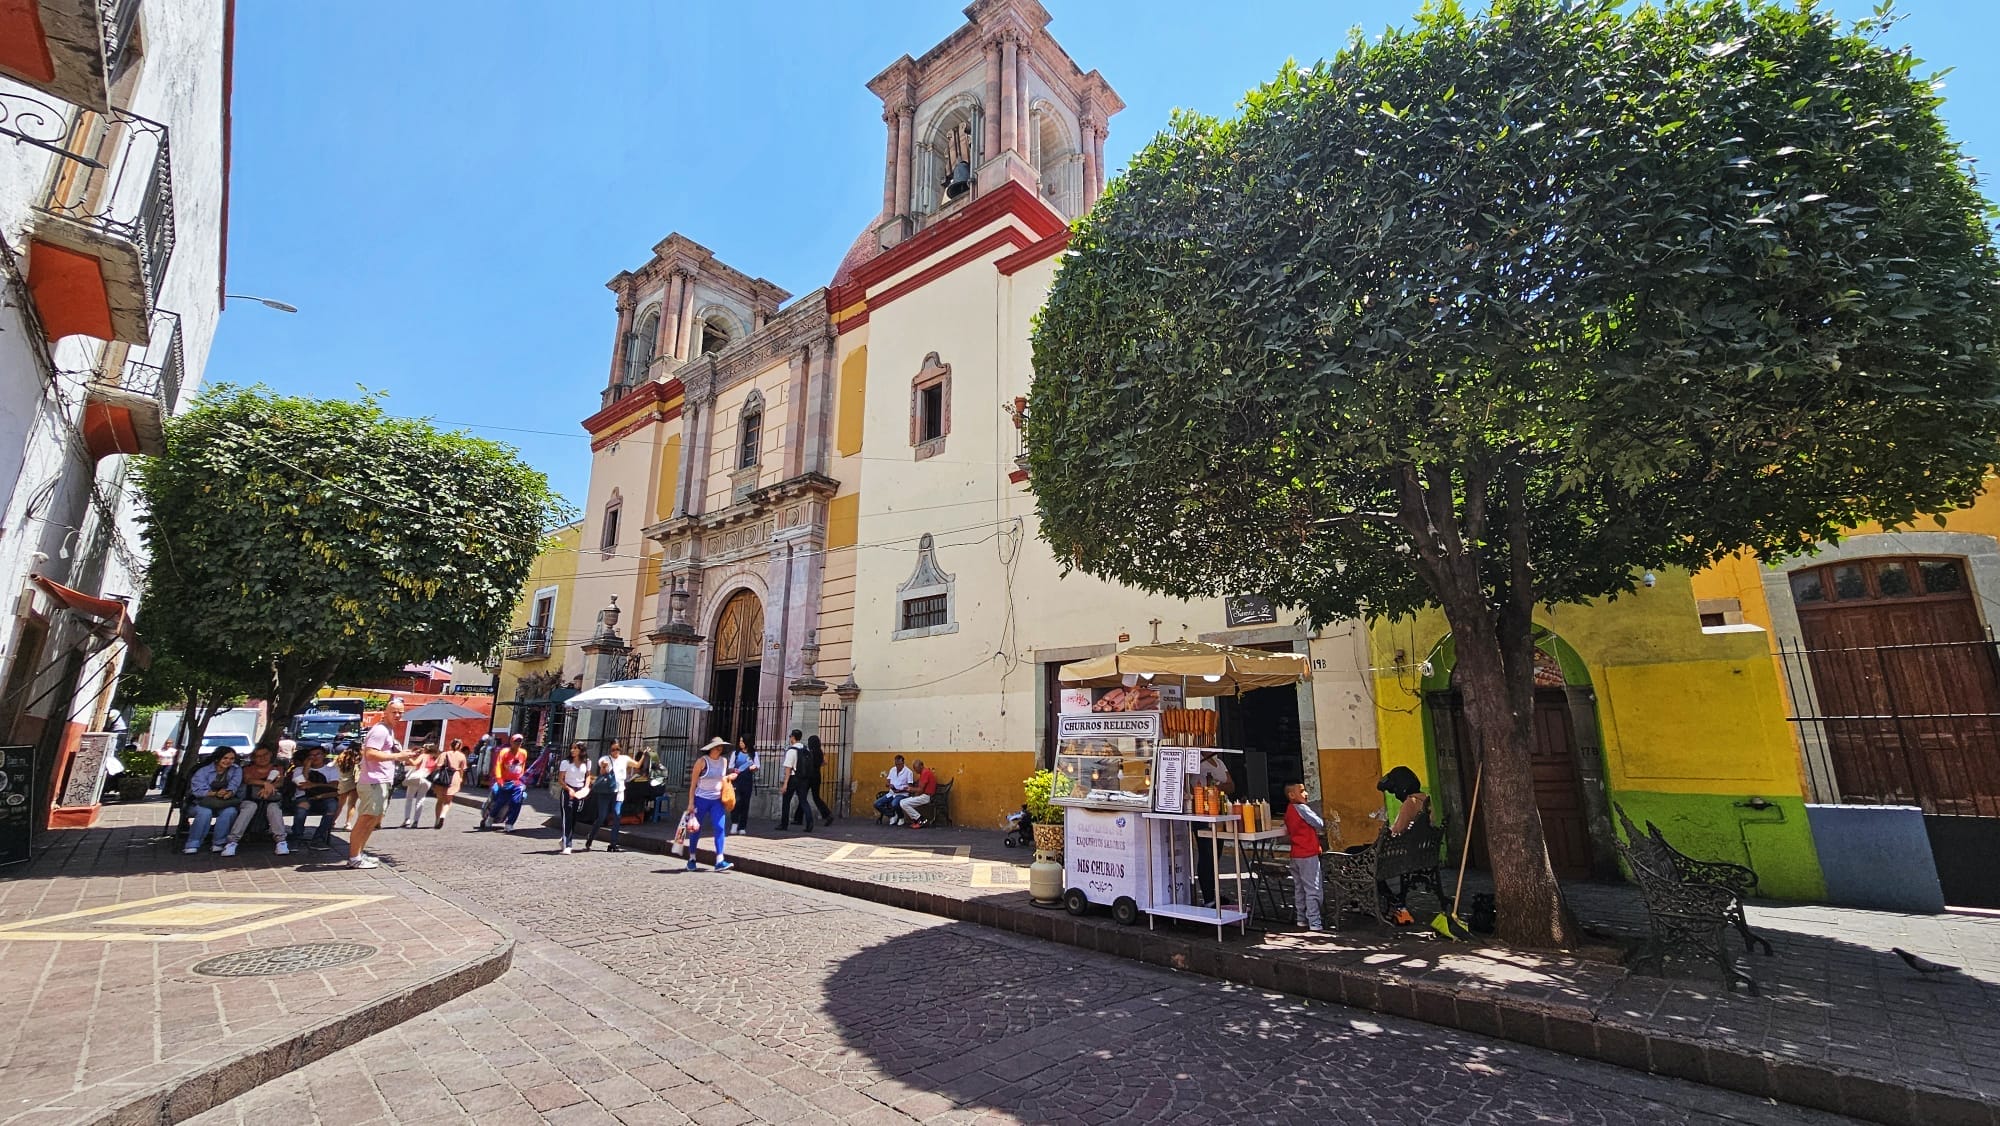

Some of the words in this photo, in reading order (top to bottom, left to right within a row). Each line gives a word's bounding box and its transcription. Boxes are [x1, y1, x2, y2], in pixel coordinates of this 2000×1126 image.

[1064, 721, 1101, 731] CHURROS
[1103, 720, 1150, 730] RELLENOS
[1077, 858, 1090, 874] MIS
[1091, 860, 1125, 879] CHURROS
